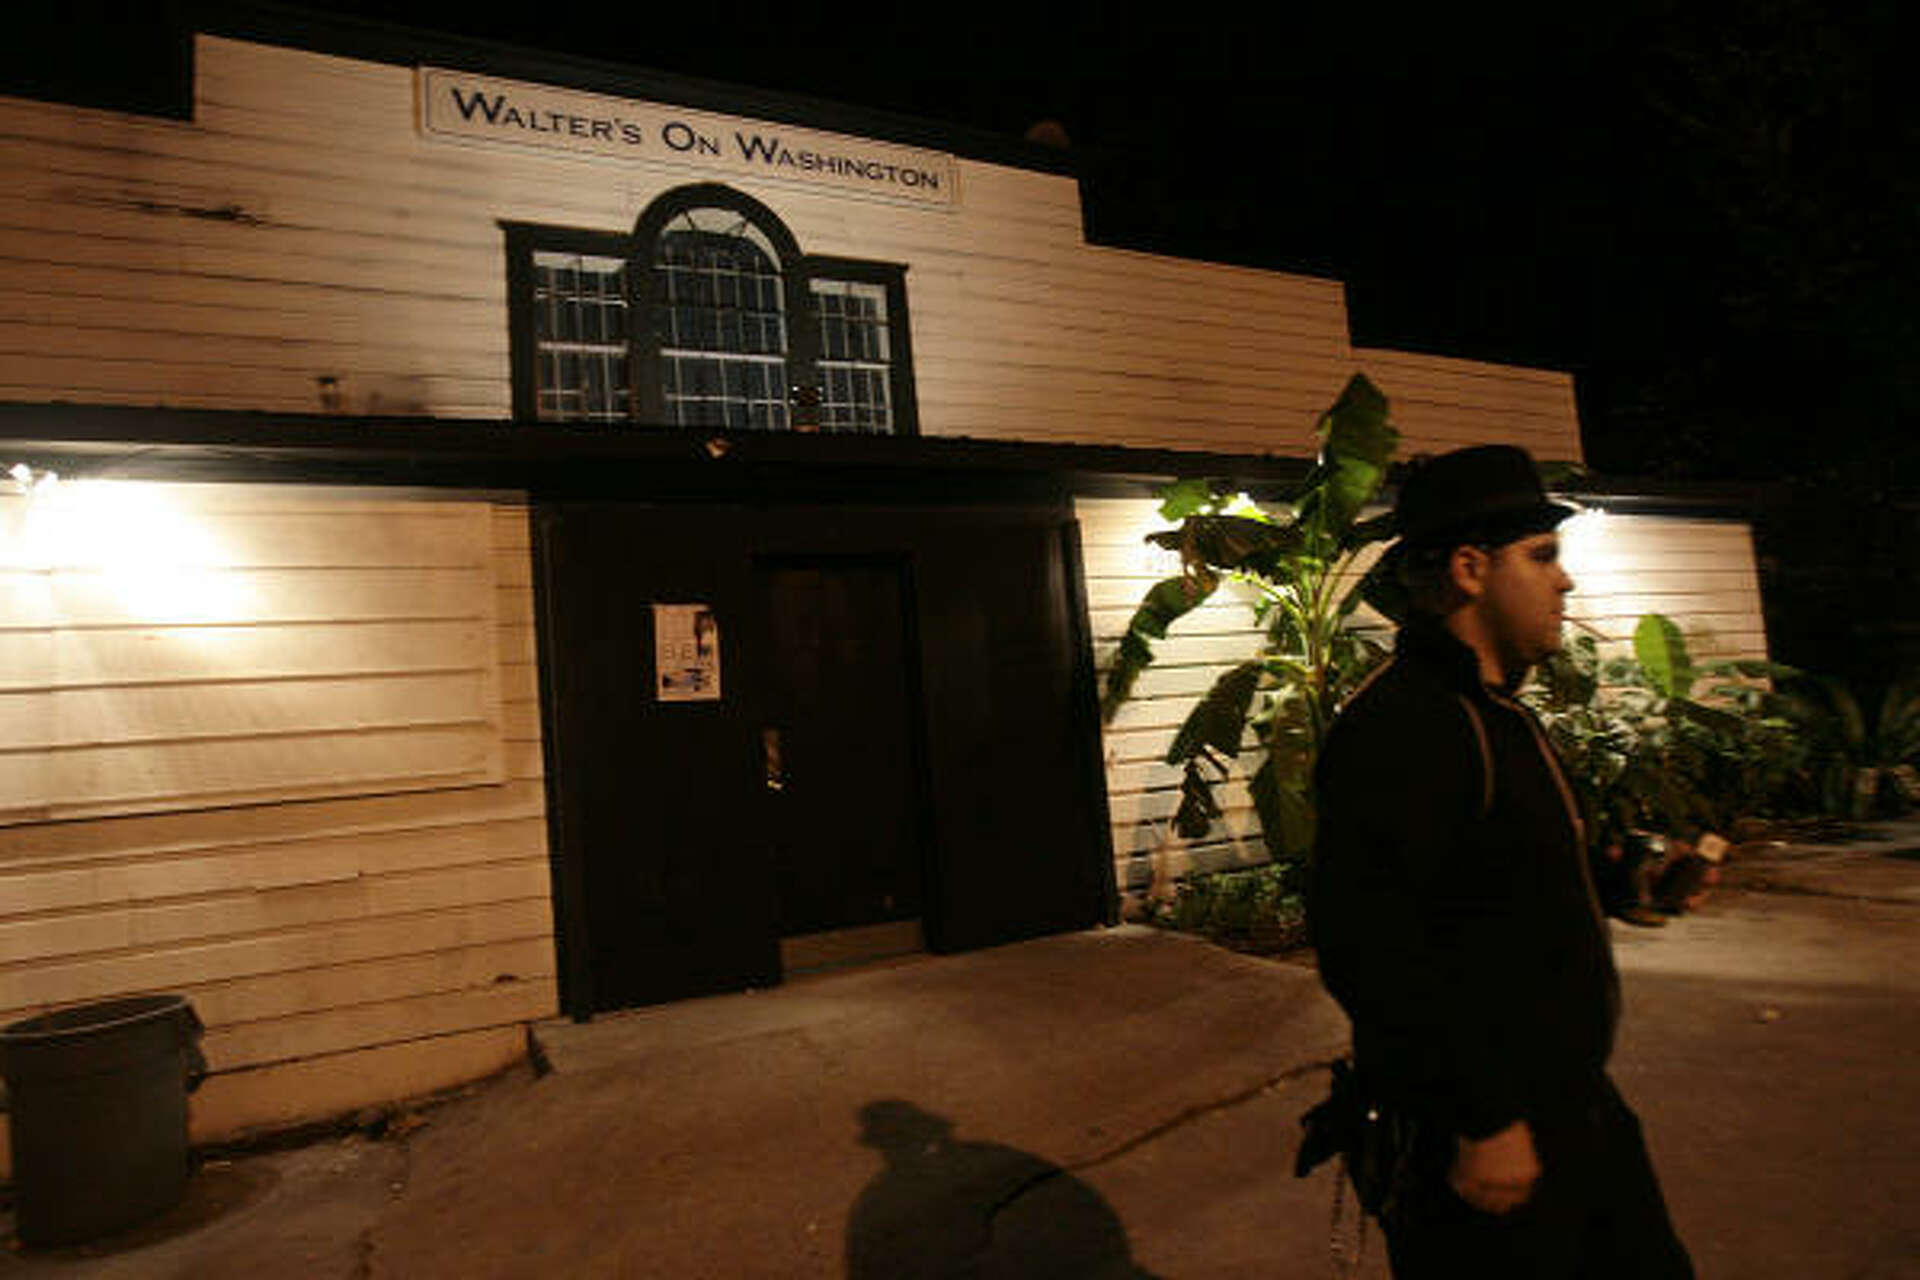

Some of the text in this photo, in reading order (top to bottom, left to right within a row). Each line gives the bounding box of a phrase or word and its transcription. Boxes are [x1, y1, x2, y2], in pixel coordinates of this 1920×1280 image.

[451, 87, 941, 190] WALTER'S ON WASHINGTON
